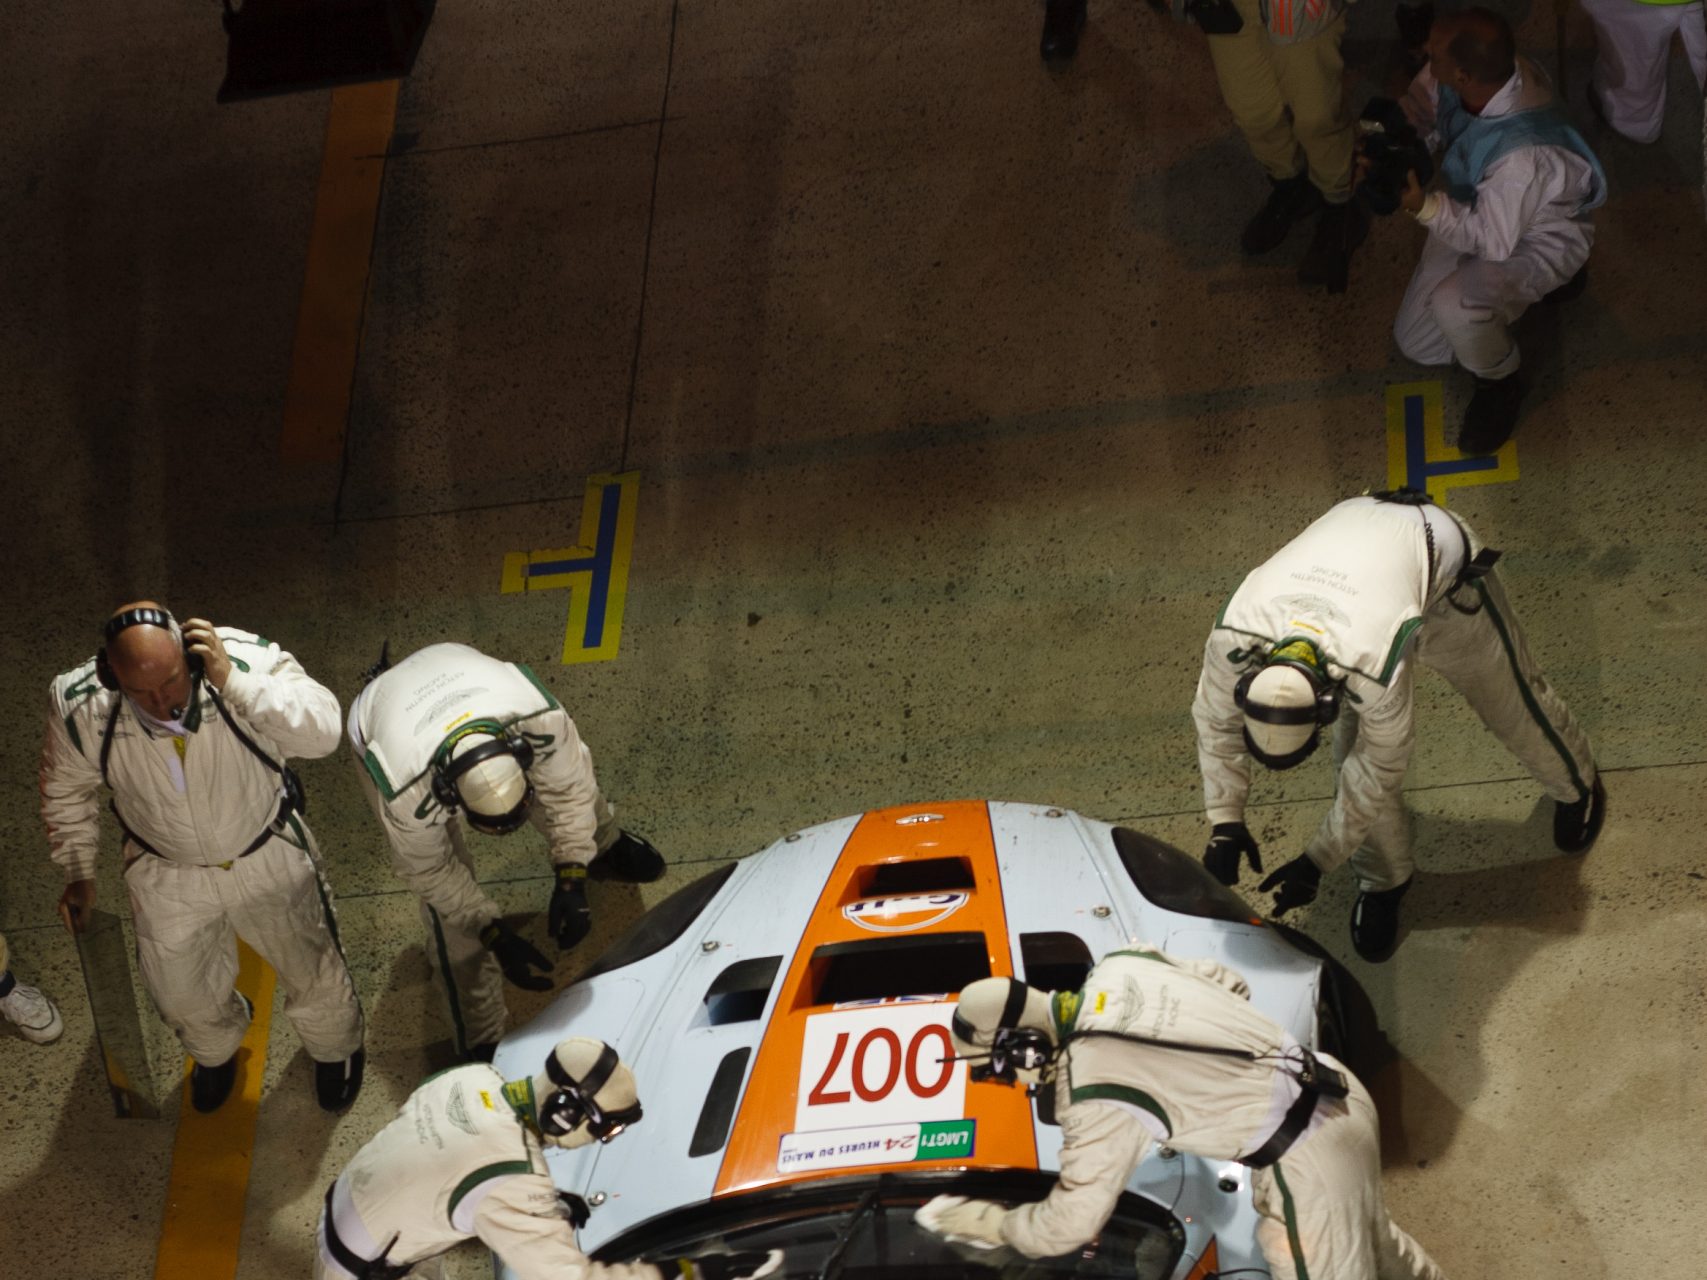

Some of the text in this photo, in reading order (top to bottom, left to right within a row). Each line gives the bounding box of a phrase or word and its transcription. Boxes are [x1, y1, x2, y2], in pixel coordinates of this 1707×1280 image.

[808, 1023, 956, 1107] 007
[838, 1139, 881, 1155] HEURES
[884, 1134, 918, 1151] 24
[920, 1130, 970, 1148] LMGT1
[818, 1146, 835, 1158] DU
